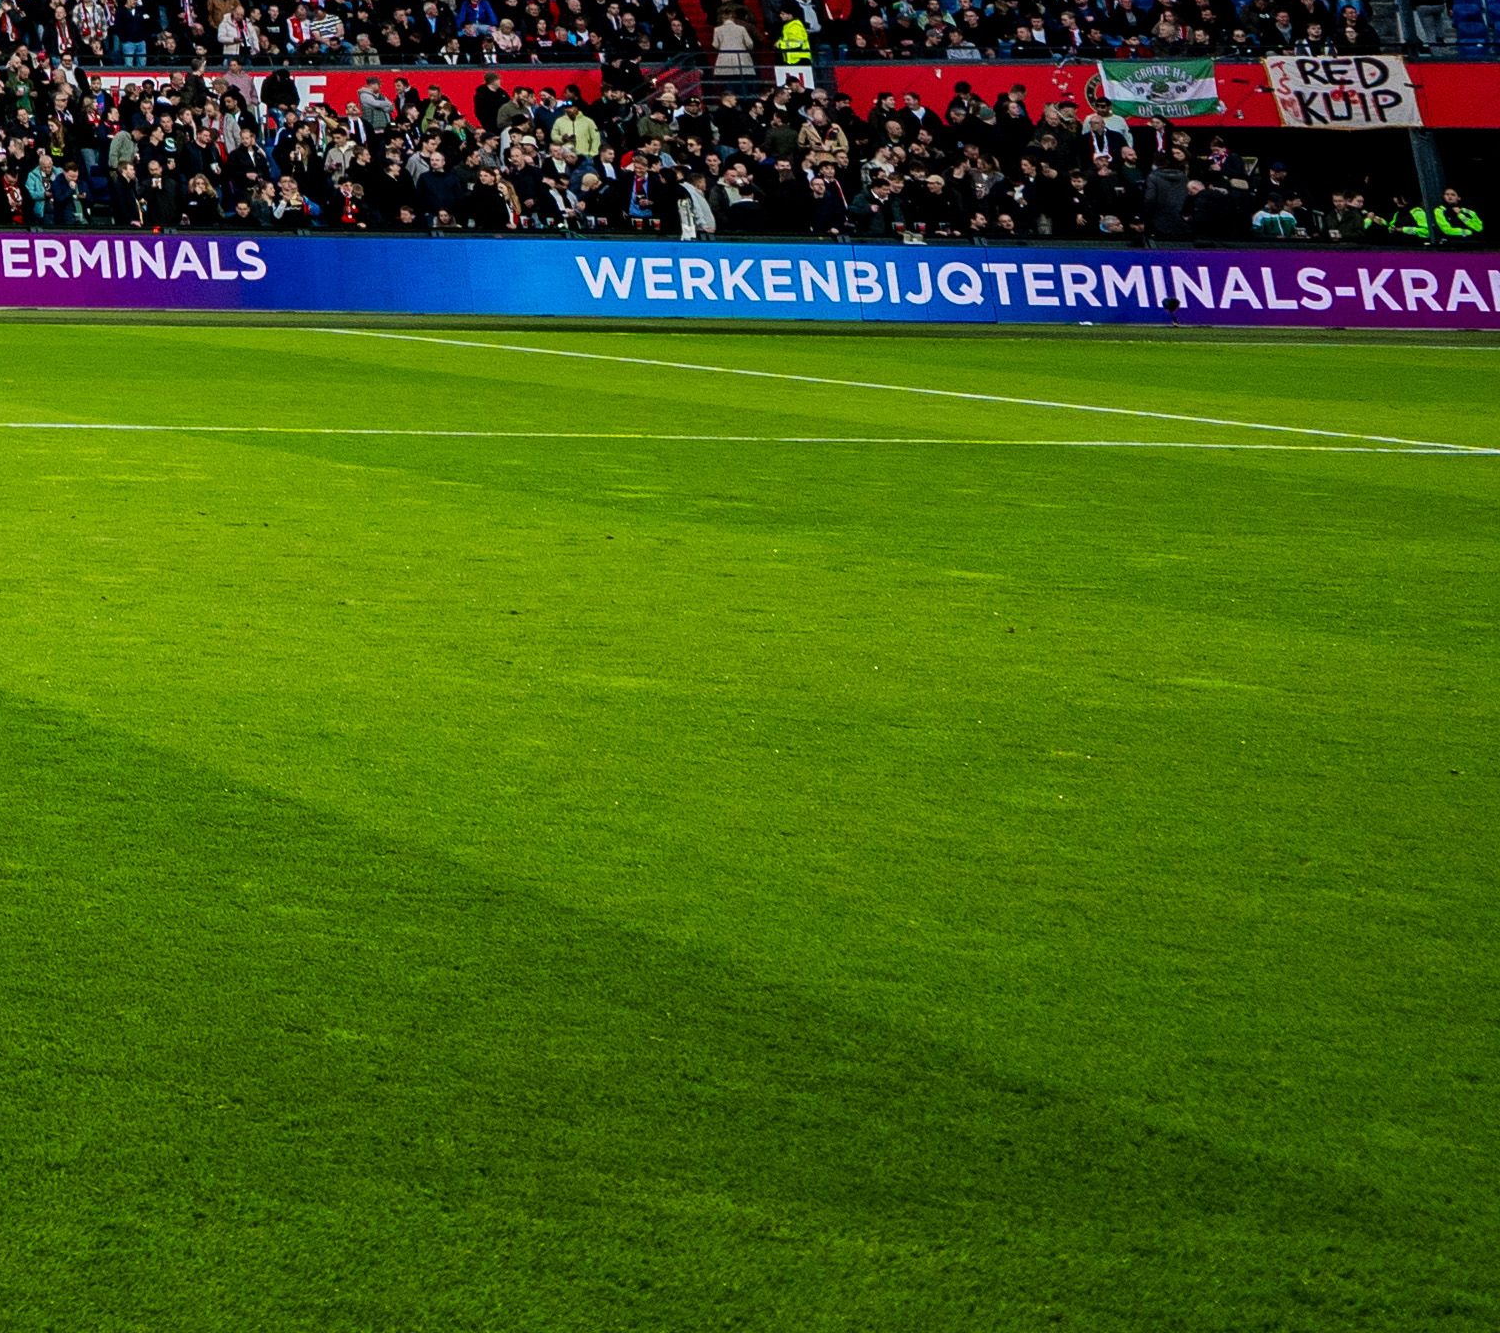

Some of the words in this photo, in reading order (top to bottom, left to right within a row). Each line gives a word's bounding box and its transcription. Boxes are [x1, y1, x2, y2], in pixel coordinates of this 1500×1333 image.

[1134, 64, 1169, 82] GROENE
[1295, 56, 1390, 89] RED
[1137, 105, 1154, 116] ON
[1156, 104, 1192, 117] TOUR
[1294, 89, 1403, 126] KUIP
[576, 256, 1500, 312] WERKENBIJQTERMINALS-KRA
